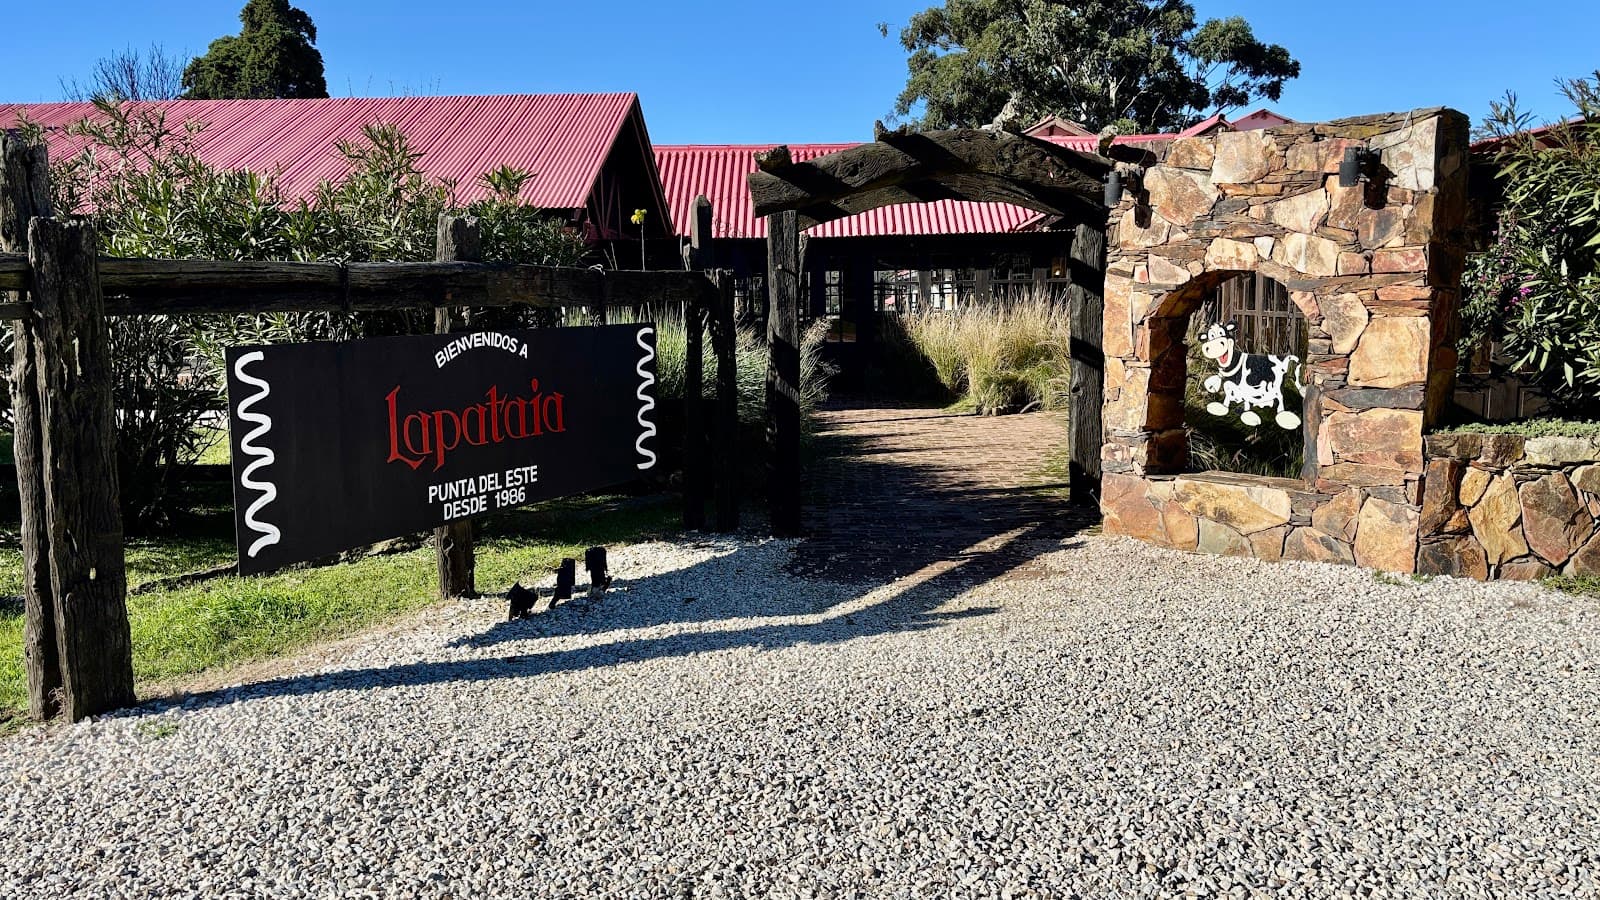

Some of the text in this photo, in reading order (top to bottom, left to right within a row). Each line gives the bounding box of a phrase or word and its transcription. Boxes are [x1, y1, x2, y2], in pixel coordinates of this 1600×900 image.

[434, 331, 528, 369] BIENVENIDOS A
[384, 378, 566, 472] Lapataia
[428, 465, 538, 504] PUNTA DEL ESTE
[443, 486, 527, 521] DESDE 1986
